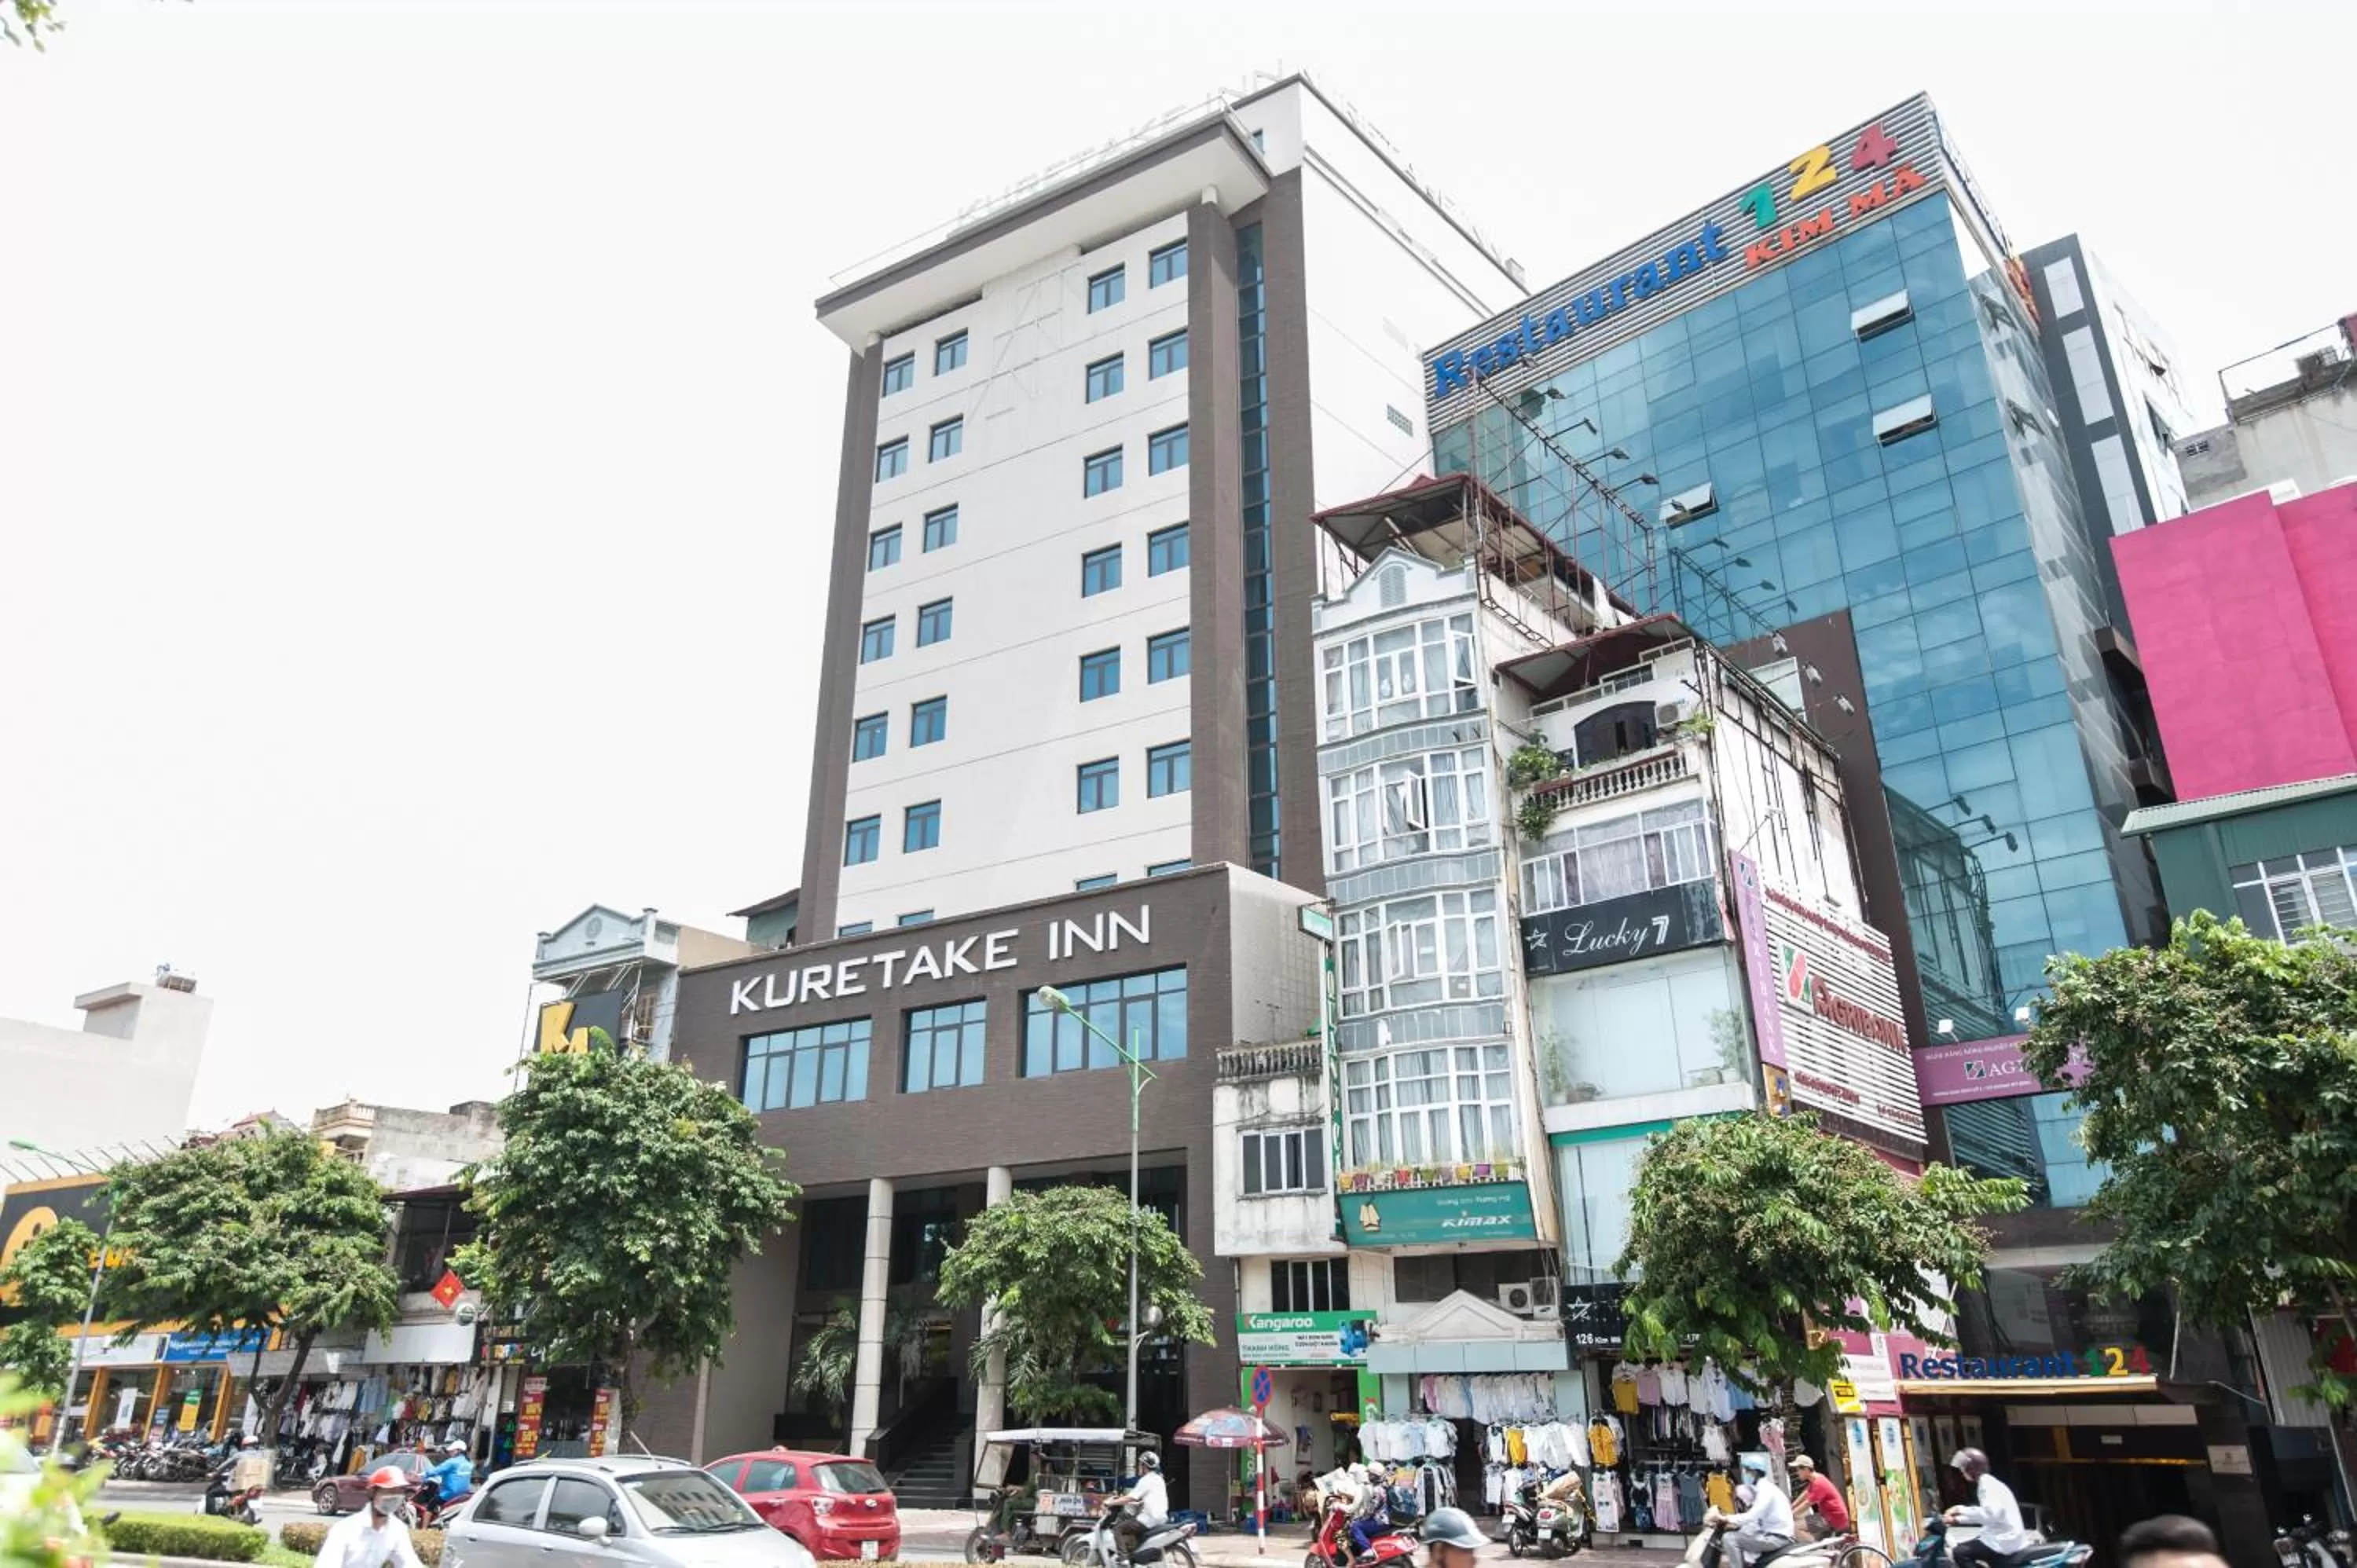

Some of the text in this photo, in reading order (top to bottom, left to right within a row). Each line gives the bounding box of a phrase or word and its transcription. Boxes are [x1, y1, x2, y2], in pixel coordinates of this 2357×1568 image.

[1431, 218, 1730, 398] Restaurant
[1739, 122, 1898, 229] 124
[1743, 207, 1838, 271] KIM
[730, 904, 1150, 1016] KURETAKE INN
[1563, 914, 1670, 956] Lucky 7
[1244, 1314, 1313, 1331] Kangaroo
[1899, 1345, 2152, 1379] Restaurant 124
